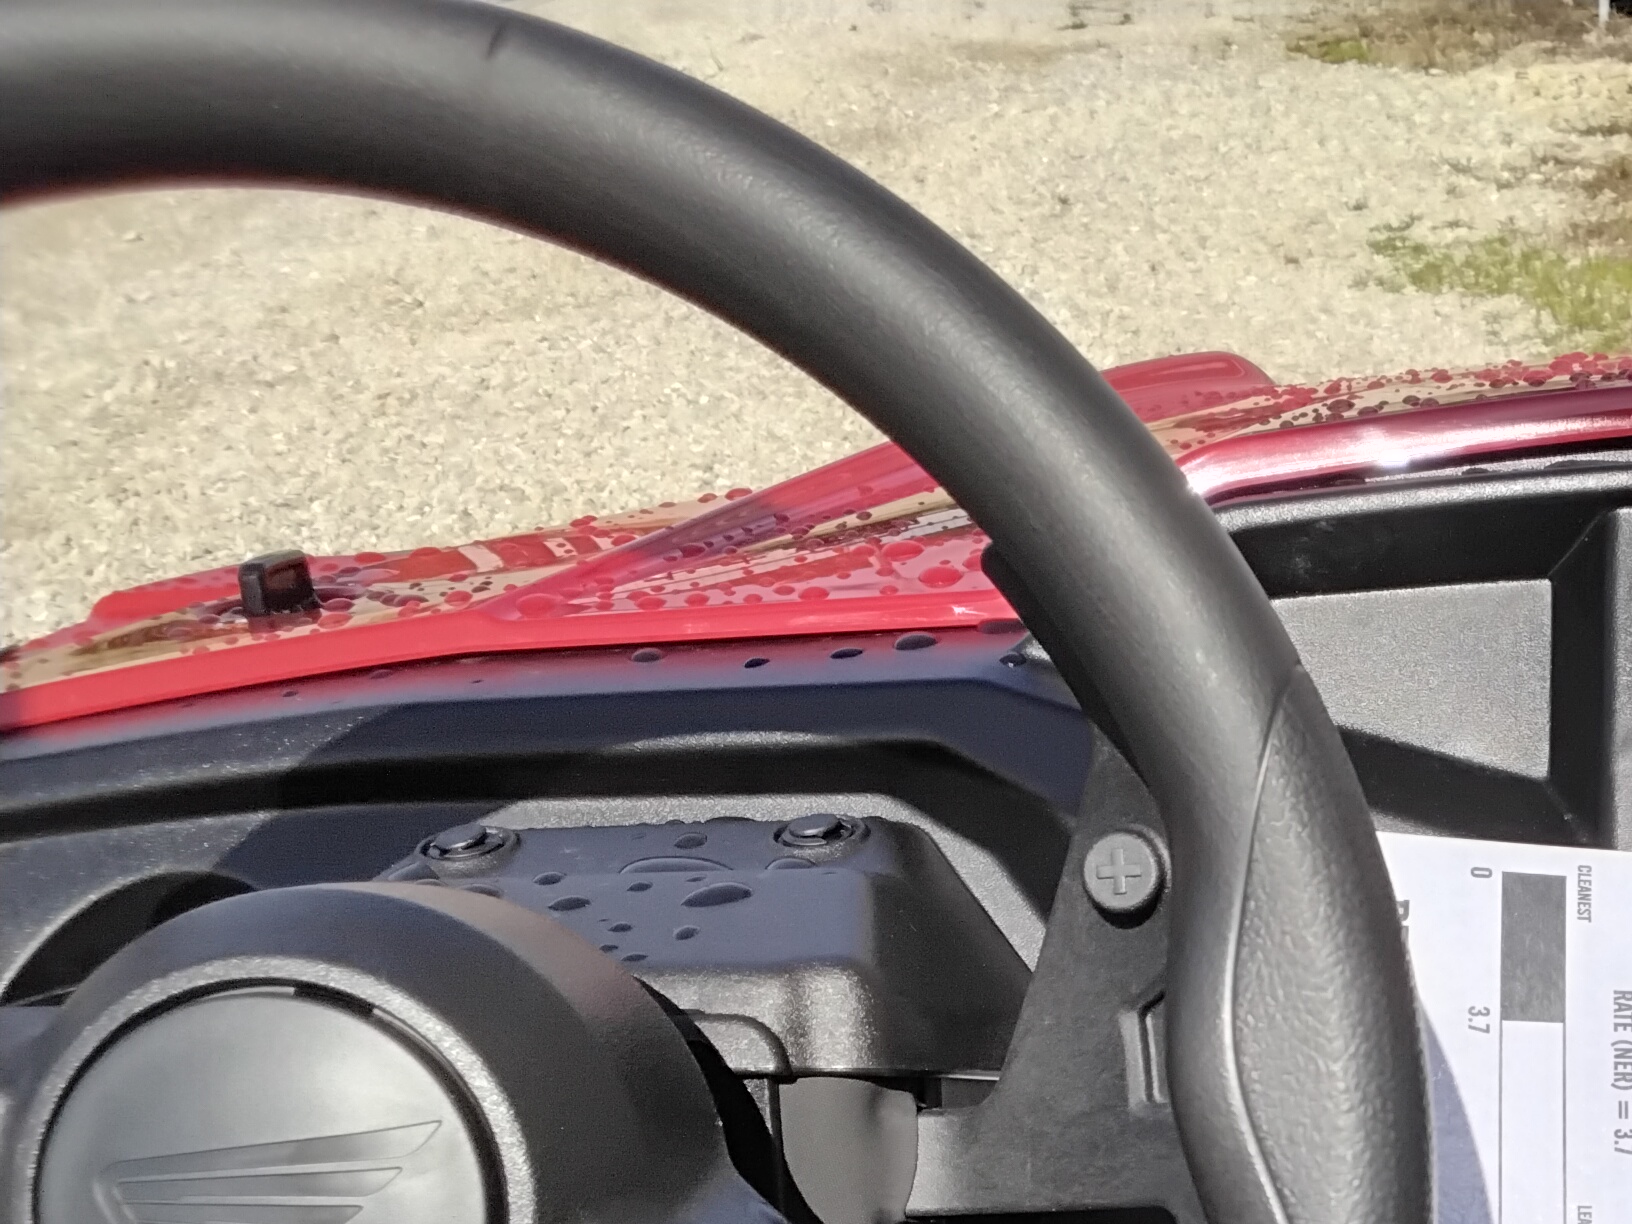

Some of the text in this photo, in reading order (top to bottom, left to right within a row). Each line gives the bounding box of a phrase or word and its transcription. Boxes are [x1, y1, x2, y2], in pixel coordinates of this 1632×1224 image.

[1470, 867, 1493, 879] 0
[1577, 864, 1592, 923] CLEANEST
[1468, 1006, 1490, 1034] 3.7
